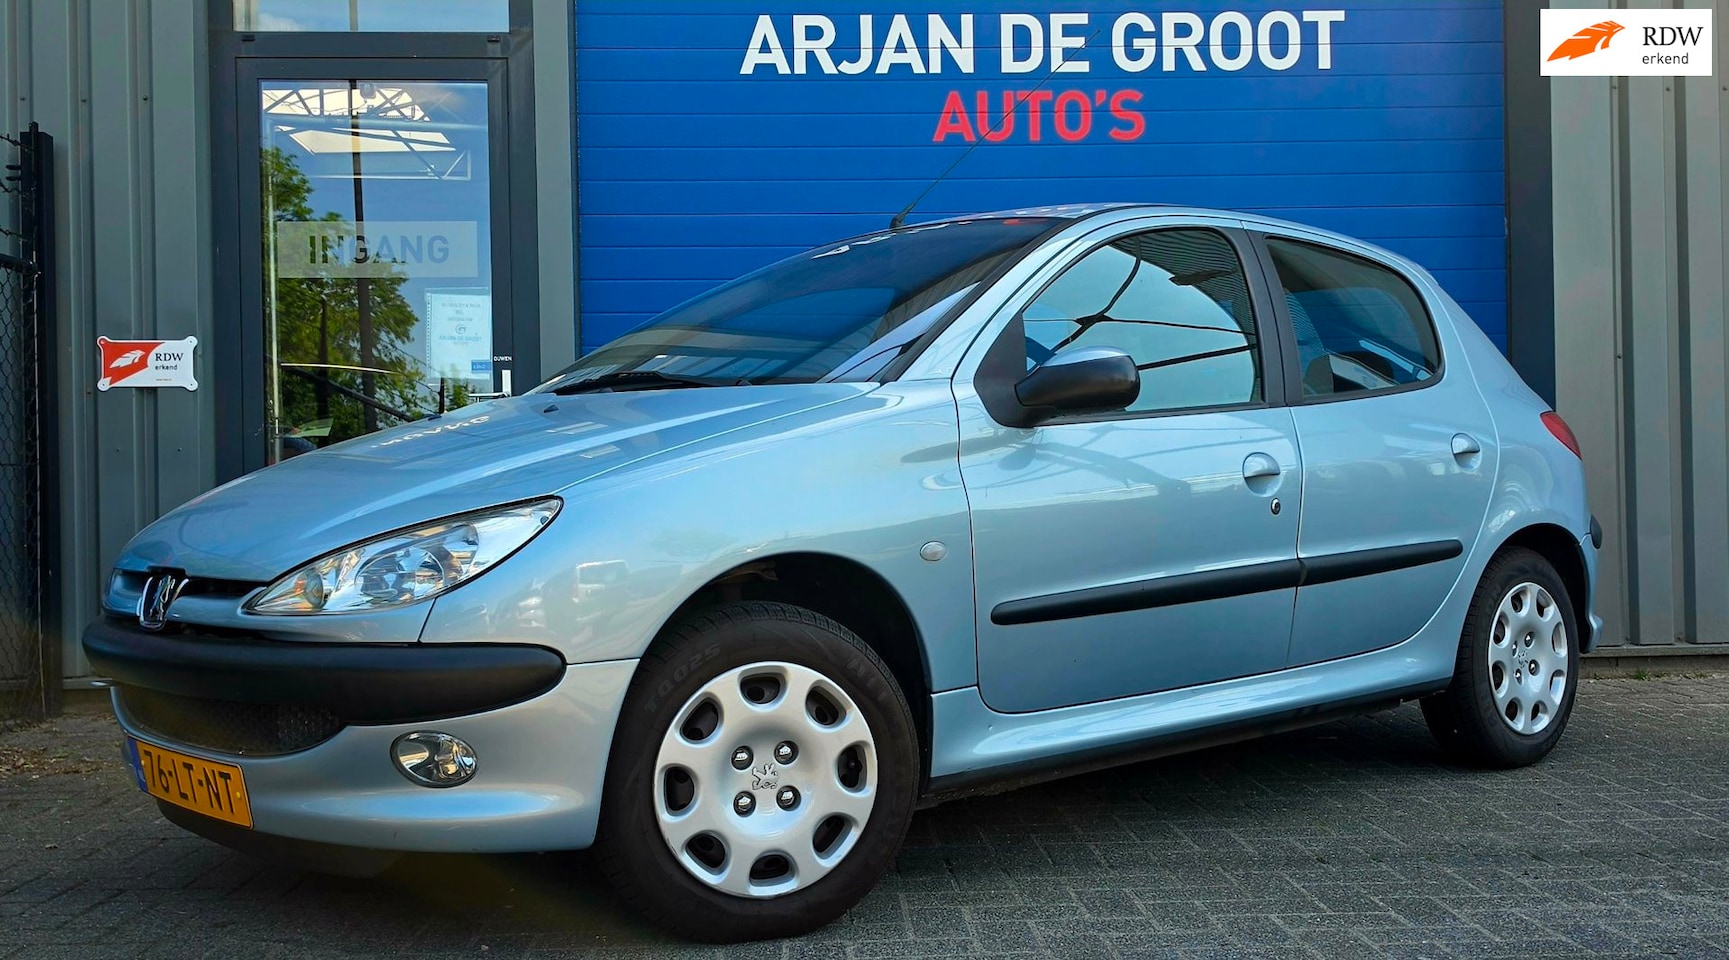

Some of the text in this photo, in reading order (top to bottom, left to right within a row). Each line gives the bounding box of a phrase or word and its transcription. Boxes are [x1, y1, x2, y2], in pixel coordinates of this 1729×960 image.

[740, 10, 1345, 75] ARJAN DE GROOT
[932, 90, 1146, 143] AUTO'S
[309, 235, 450, 264] INGANG
[155, 352, 184, 362] RDW
[143, 750, 234, 814] 76-LT-NT
